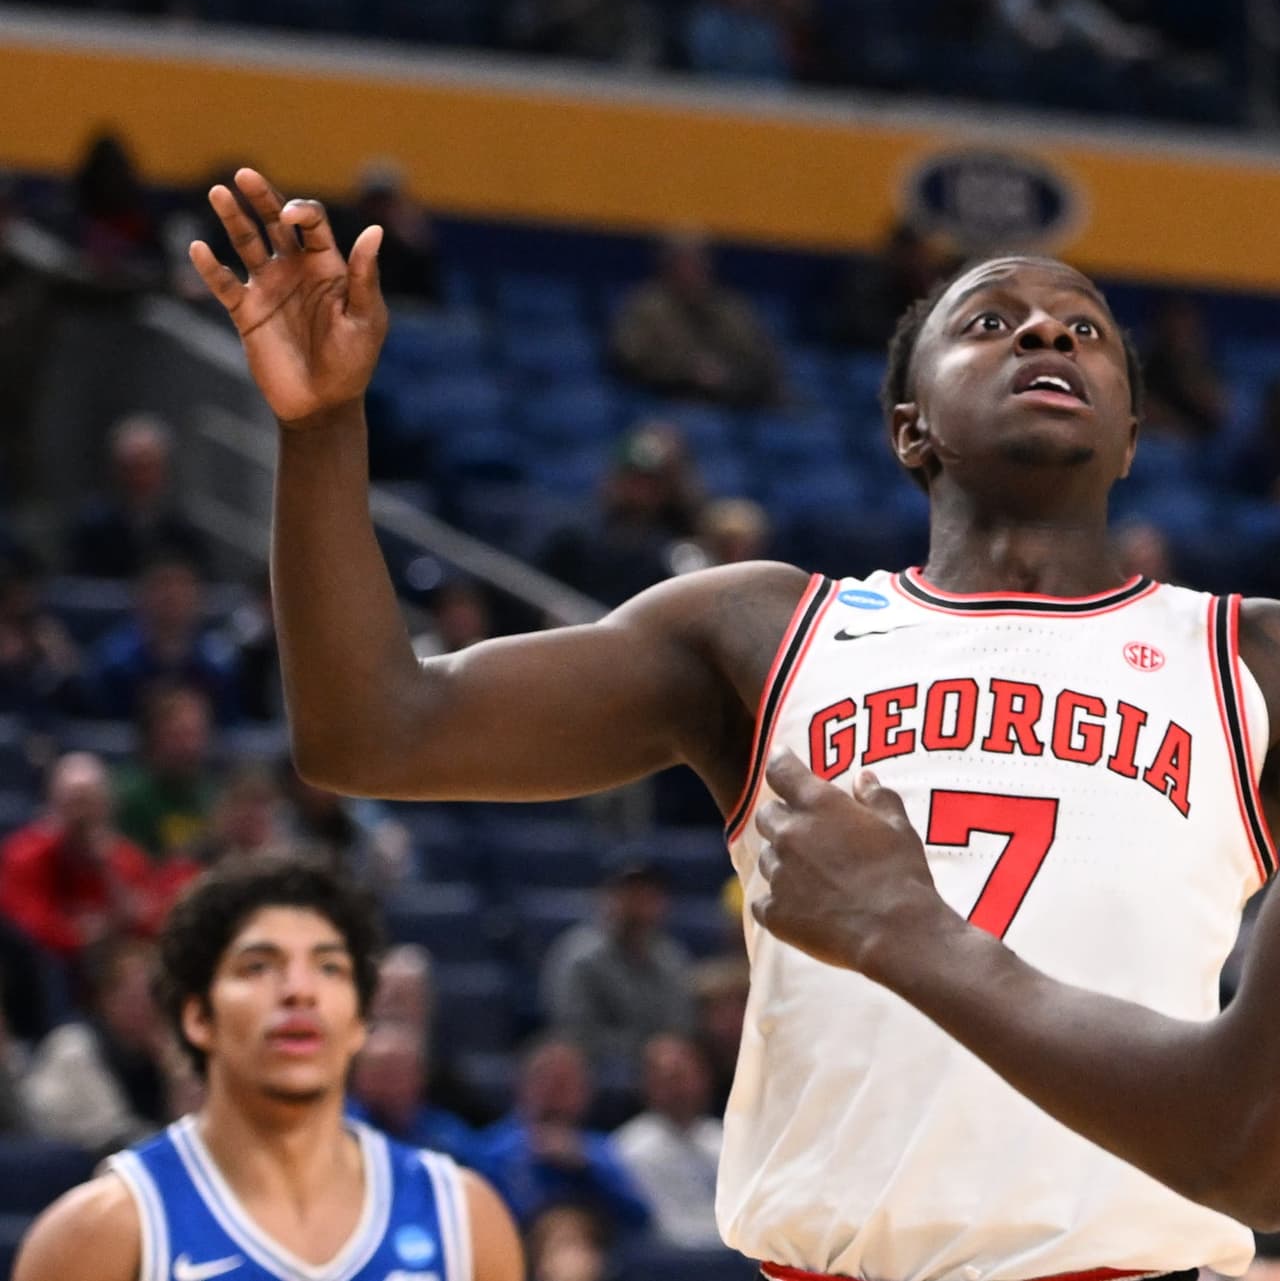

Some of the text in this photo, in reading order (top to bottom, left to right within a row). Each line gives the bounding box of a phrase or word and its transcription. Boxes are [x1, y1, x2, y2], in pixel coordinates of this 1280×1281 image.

[1128, 644, 1160, 669] SEC
[808, 677, 1192, 819] GEORGIA
[926, 788, 1060, 941] 7
